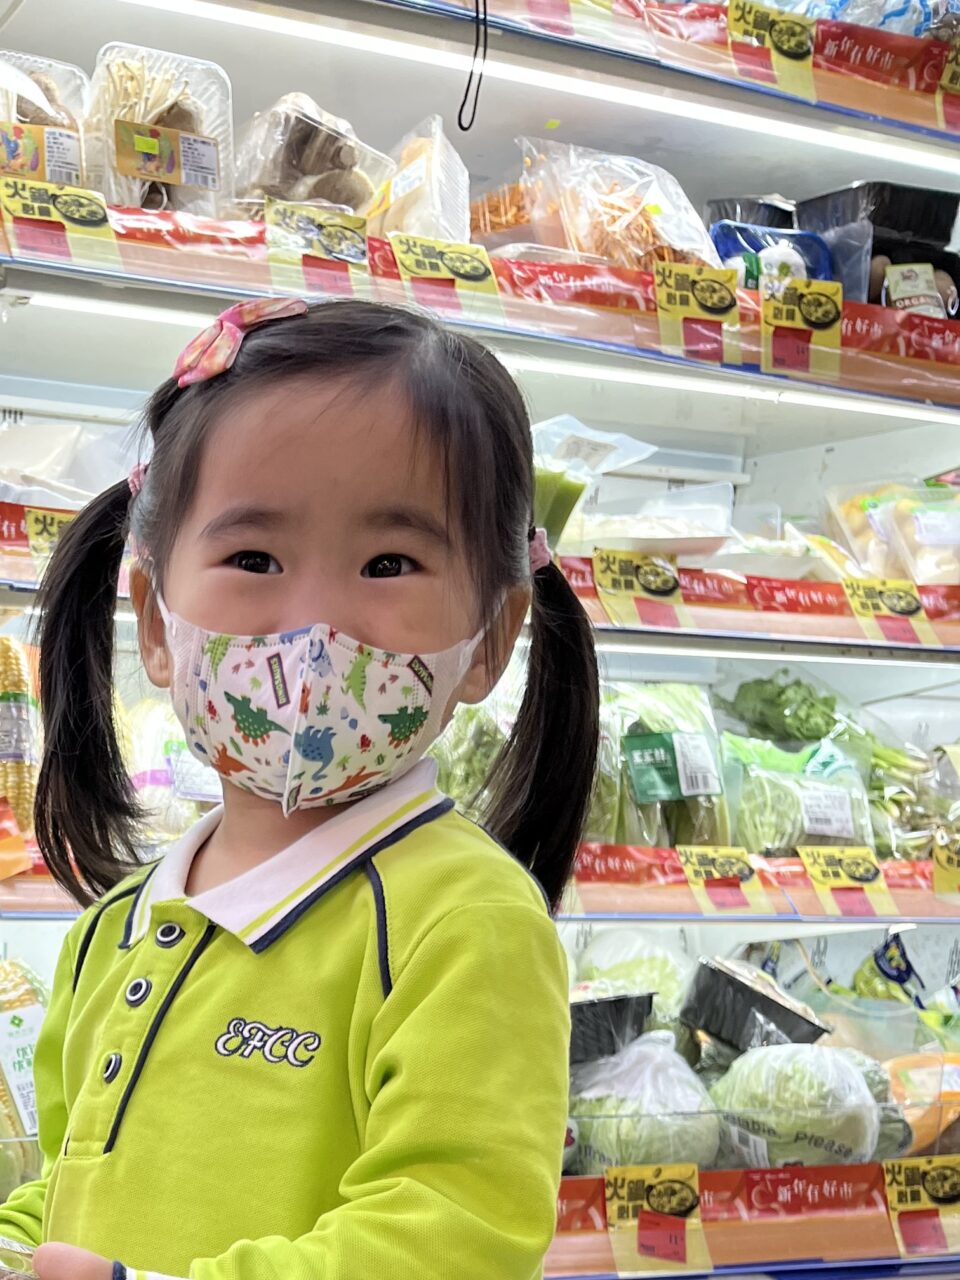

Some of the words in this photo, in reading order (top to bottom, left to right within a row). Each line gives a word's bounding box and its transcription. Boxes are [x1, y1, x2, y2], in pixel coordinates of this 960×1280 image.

[215, 1017, 321, 1067] EFCC
[778, 1178, 854, 1204] 新年有好市
